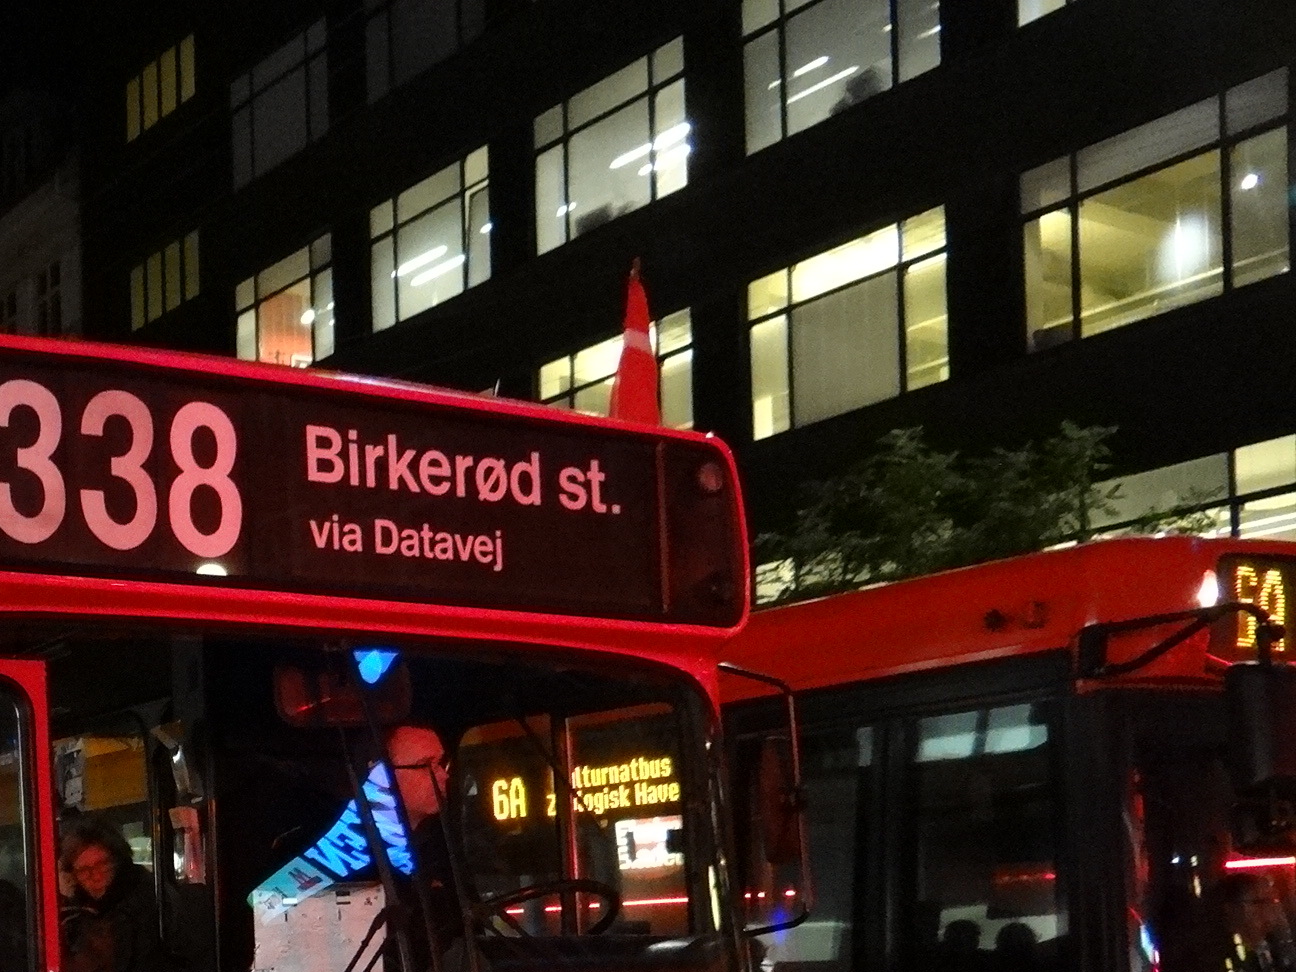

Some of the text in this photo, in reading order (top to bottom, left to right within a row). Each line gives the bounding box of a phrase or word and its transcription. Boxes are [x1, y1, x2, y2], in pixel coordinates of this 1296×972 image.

[306, 424, 542, 507] Birkerød
[558, 459, 621, 515] st.
[309, 513, 503, 571] via Datavej
[1236, 565, 1286, 652] 6A
[492, 776, 528, 820] 6A
[546, 781, 681, 816] Zlogisk Have
[549, 756, 673, 790] lturnatbus
